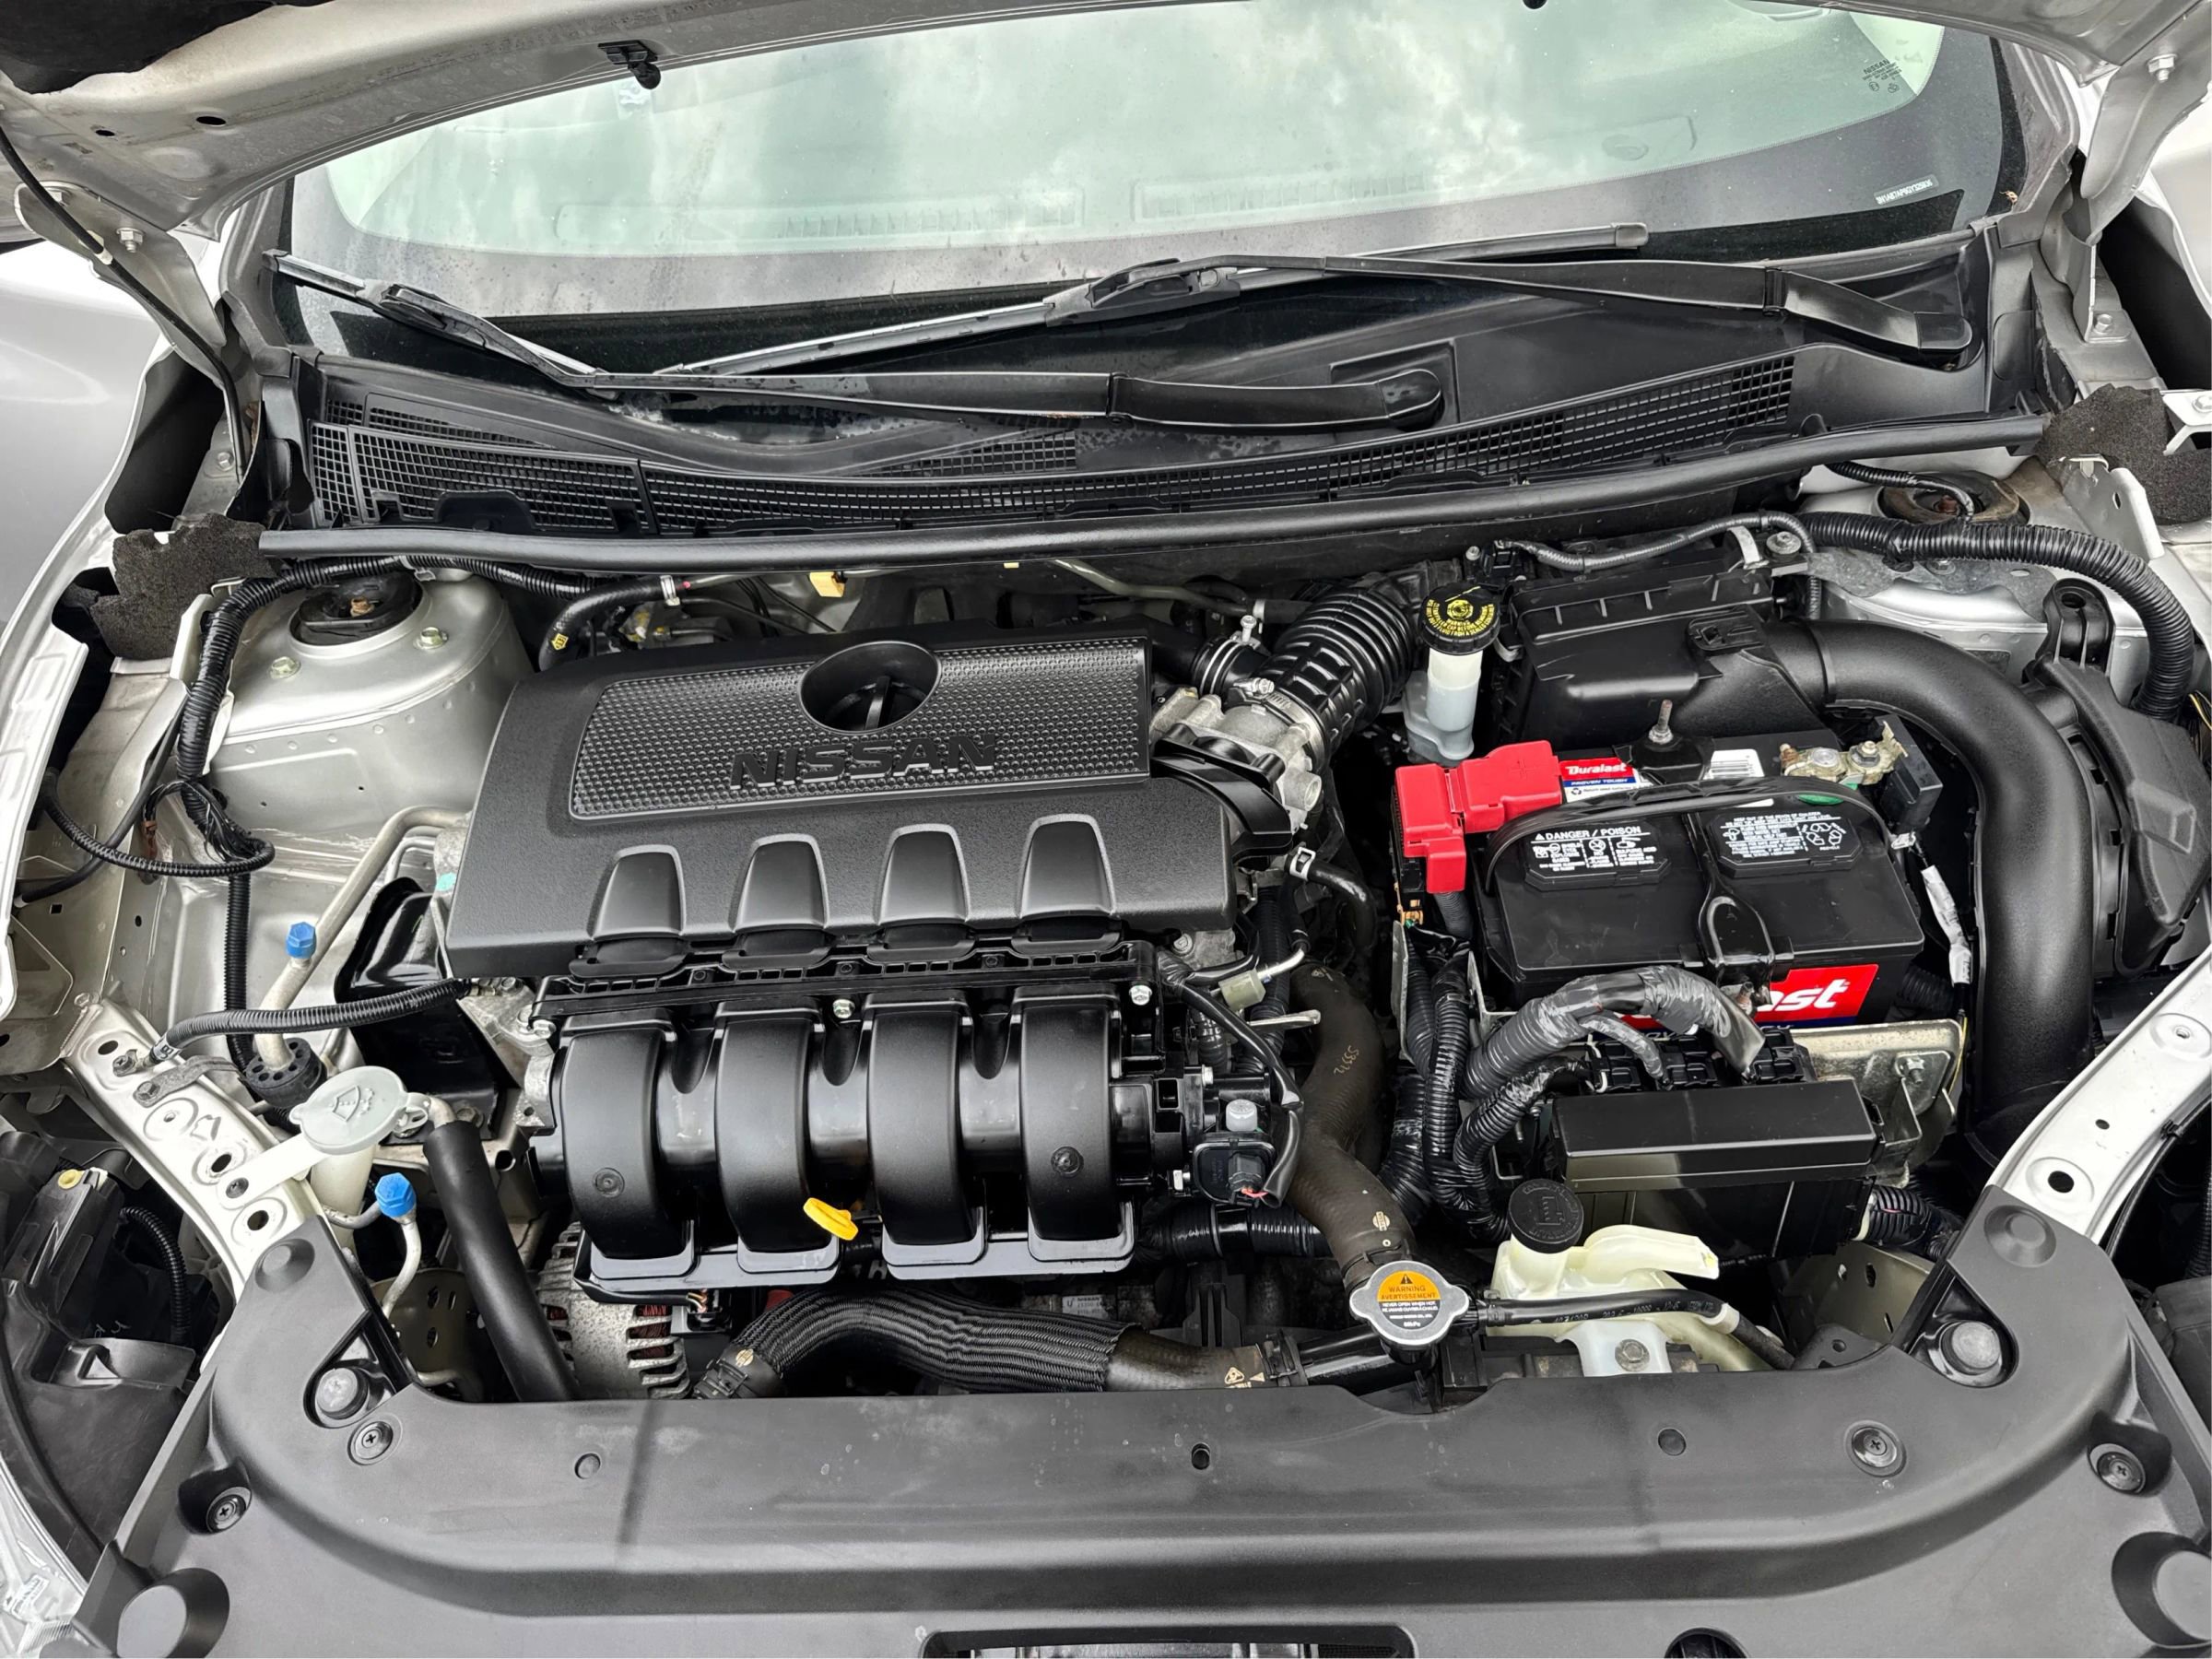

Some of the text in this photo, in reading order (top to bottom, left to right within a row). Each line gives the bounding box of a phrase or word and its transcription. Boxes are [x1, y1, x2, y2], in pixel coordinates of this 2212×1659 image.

[730, 734, 995, 790] NISSAN
[1565, 762, 1628, 775] Duralast
[1546, 830, 1590, 841] DANGER
[1600, 826, 1641, 836] POISON
[1381, 1292, 1436, 1300] AVERTISSEMENT
